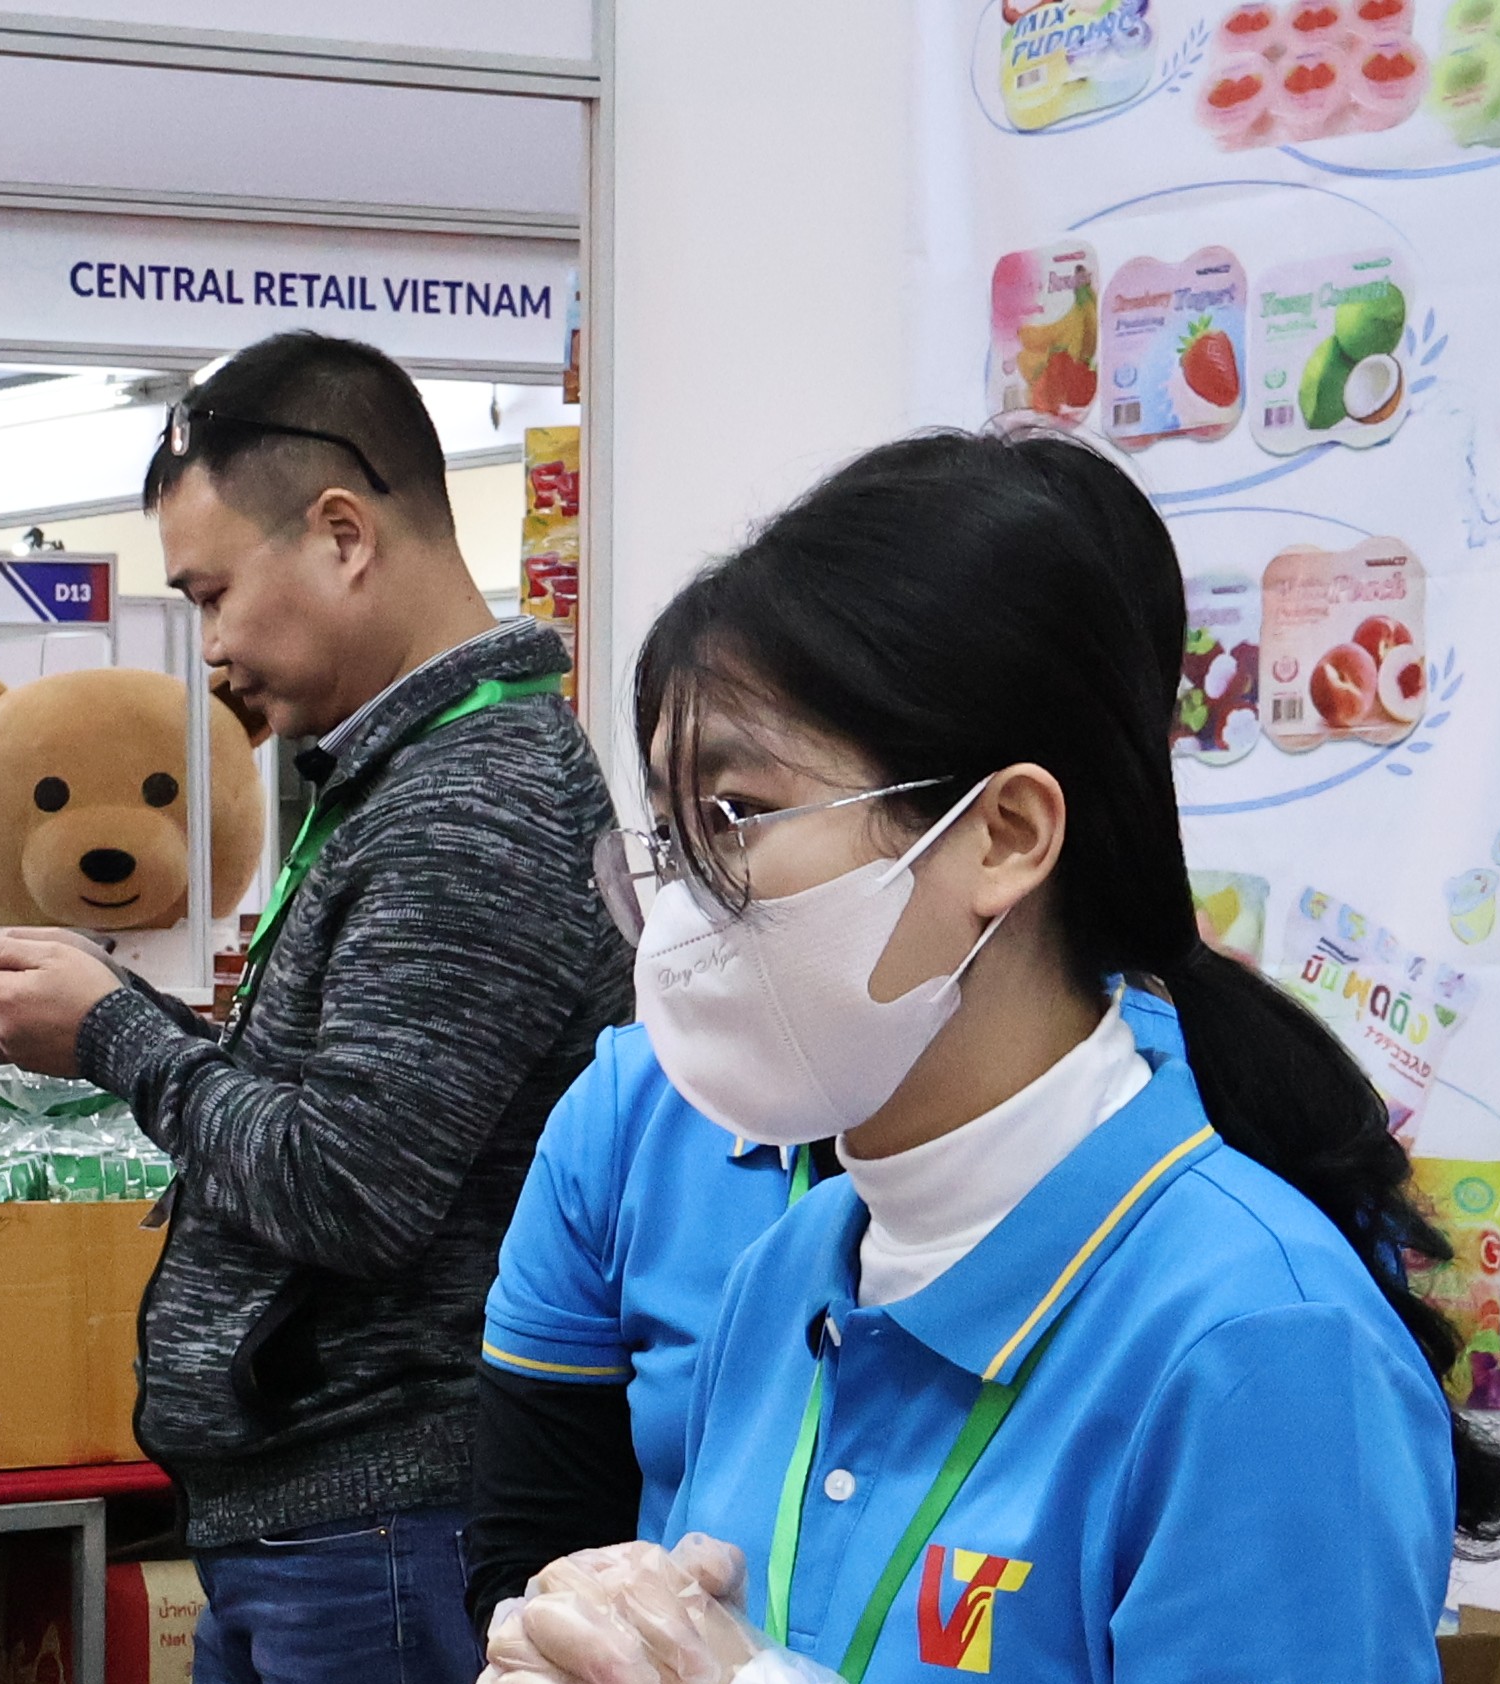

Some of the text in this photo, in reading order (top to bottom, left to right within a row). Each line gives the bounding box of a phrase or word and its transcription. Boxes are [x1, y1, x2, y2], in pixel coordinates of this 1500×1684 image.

[69, 260, 552, 320] CENTRAL RETAIL VIETNAM
[55, 582, 92, 602] D13
